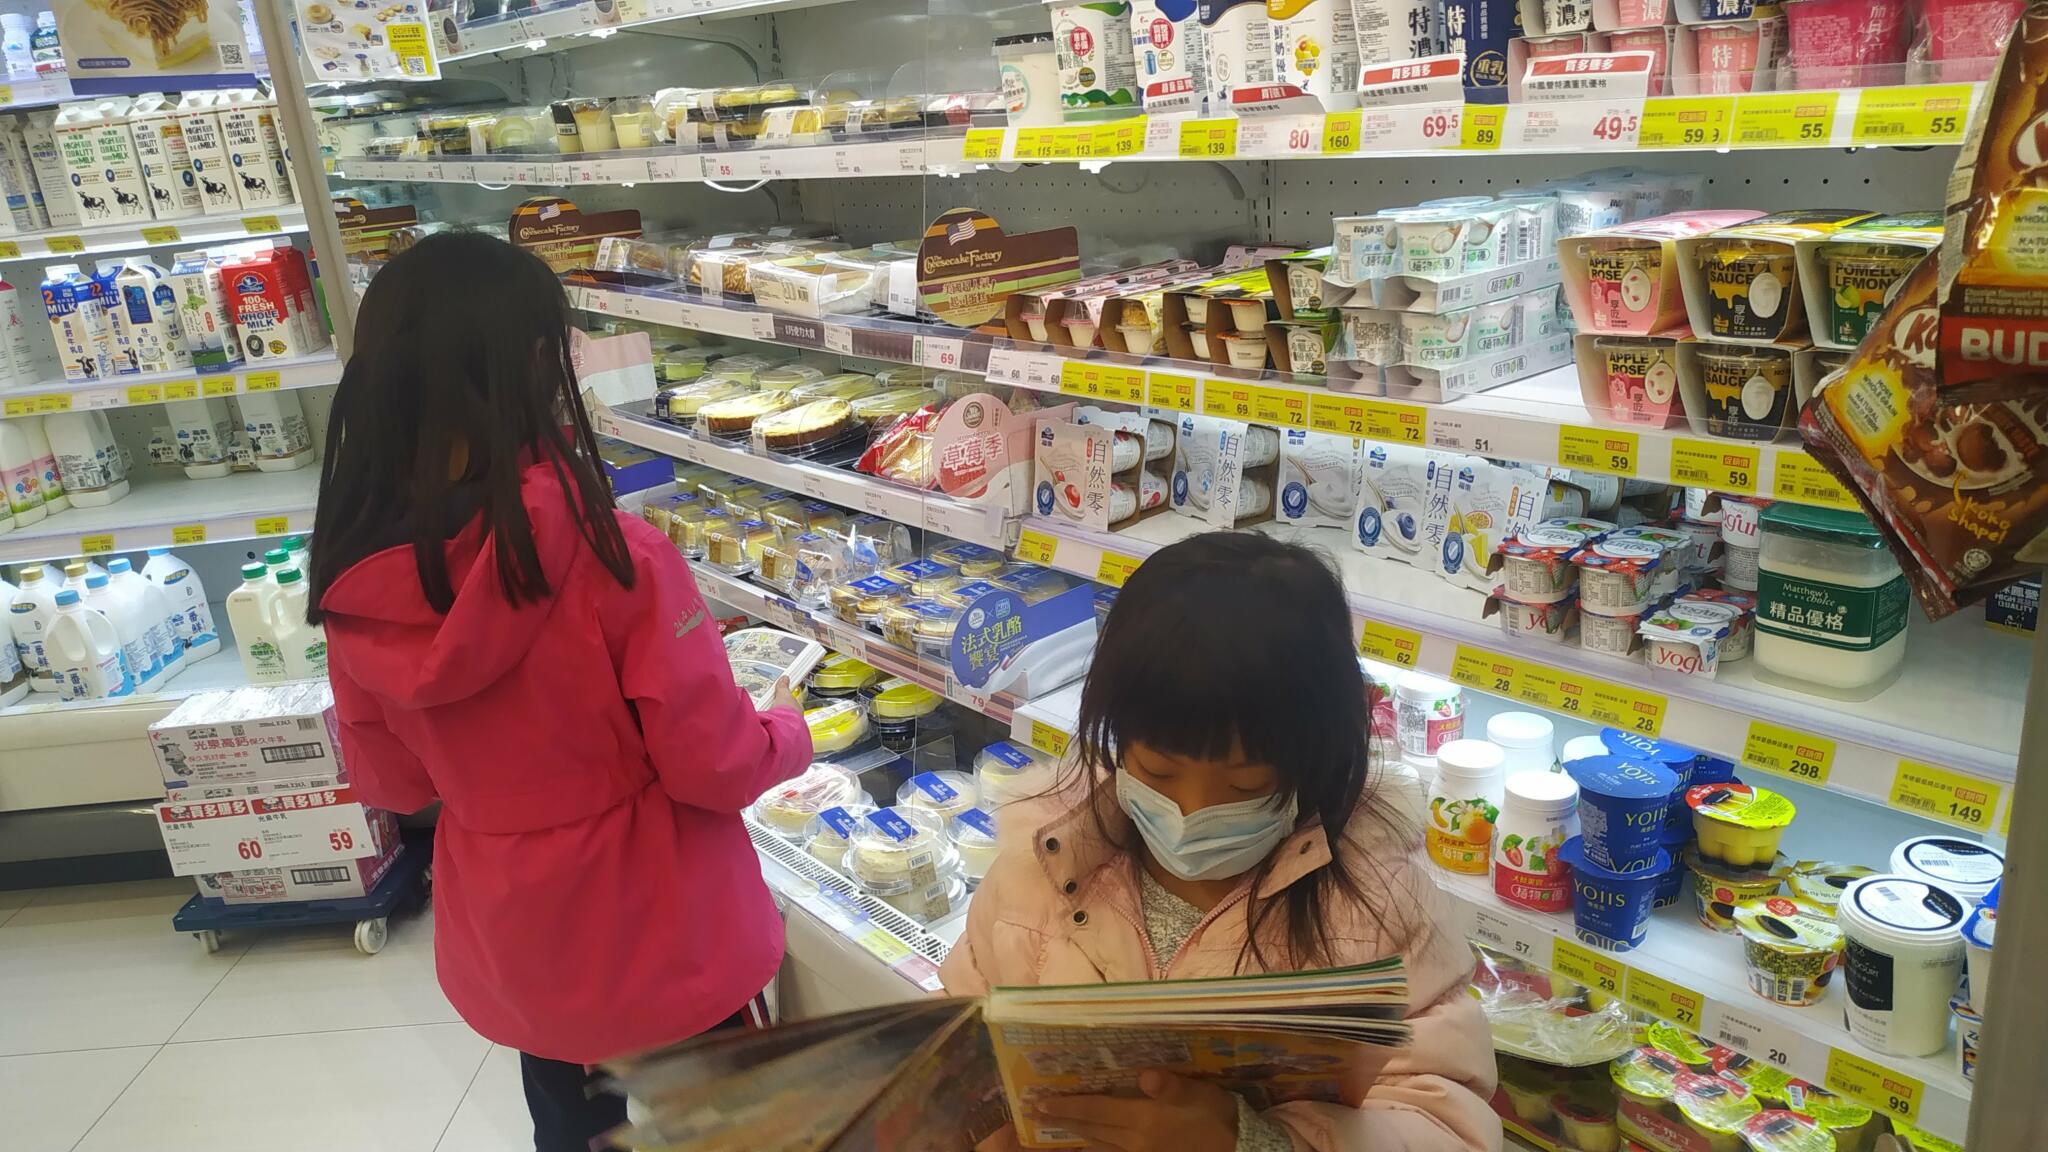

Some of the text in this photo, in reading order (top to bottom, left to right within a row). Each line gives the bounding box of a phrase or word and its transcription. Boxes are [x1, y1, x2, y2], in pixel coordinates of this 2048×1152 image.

[1556, 5, 1577, 27] 濃
[392, 26, 420, 34] COFFEE
[1409, 6, 1432, 58] 特濃
[1478, 59, 1505, 76] 重乳
[186, 126, 201, 134] HIGH
[225, 121, 241, 129] HIGH
[1423, 114, 1458, 138] 69.5
[1593, 115, 1638, 140] 49.5
[1800, 123, 1823, 138] 55
[1930, 117, 1956, 133] 55
[188, 133, 214, 142] QUALITY
[228, 128, 255, 137] QUALITY
[1476, 130, 1494, 143] 89
[1684, 129, 1704, 143] 59
[240, 136, 257, 144] MILK
[1116, 140, 1131, 151] 139
[1289, 130, 1309, 149] 80
[1329, 135, 1349, 148] 160
[65, 148, 94, 157] QUALITY
[100, 144, 127, 153] QUALITY
[984, 148, 997, 158] 155
[1037, 147, 1050, 156] 115
[1076, 145, 1090, 155] 113
[1208, 143, 1224, 153] 139
[720, 166, 731, 175] 55
[553, 224, 580, 235] Factory
[924, 256, 970, 274] Cheesecake
[966, 249, 1002, 267] Factory
[1589, 258, 1625, 270] APPLE
[1710, 261, 1756, 273] HONEY
[1591, 270, 1623, 281] ROSE
[1710, 273, 1755, 285] SAUCE
[44, 290, 54, 304] 2
[47, 303, 77, 314] MILK
[238, 302, 274, 313] FRESH
[238, 310, 279, 321] WHOLE
[247, 318, 274, 329] MILK
[1961, 328, 2048, 366] BUD
[940, 353, 953, 364] 69
[1609, 352, 1649, 365] APPLE
[1011, 370, 1020, 378] 60
[1612, 364, 1646, 375] ROSE
[1705, 363, 1748, 376] HONEY
[1051, 375, 1060, 384] 60
[1705, 375, 1748, 387] SAUCE
[1087, 383, 1097, 393] 59
[1130, 389, 1140, 399] 59
[1179, 398, 1190, 408] 54
[1237, 404, 1248, 415] 69
[1856, 392, 1879, 422] NATURAL
[1289, 412, 1302, 423] 72
[1350, 420, 1362, 432] 72
[1405, 428, 1419, 440] 72
[944, 434, 1002, 468] 草莓季
[1474, 439, 1489, 451] 51
[1605, 440, 1629, 452] 促銷價
[1611, 456, 1628, 469] 59
[1723, 455, 1750, 468] 促銷價
[1087, 440, 1106, 515] 自然零
[1217, 433, 1239, 509] 自然零
[1729, 472, 1748, 486] 59
[1425, 464, 1453, 550] 自然零
[1041, 552, 1049, 561] 62
[1783, 583, 1835, 607] Matthew's choice
[1995, 593, 2016, 603] HIGH
[1998, 601, 2034, 613] QUALITY
[1770, 600, 1844, 632] 精品優格
[962, 615, 1022, 654] 法式乳酪
[1396, 652, 1410, 664] 62
[1492, 663, 1513, 677] 促銷價
[1495, 677, 1509, 692] 28
[1560, 682, 1582, 695] 促銷價
[971, 696, 984, 707] 79
[1564, 697, 1578, 711] 28
[1633, 701, 1657, 715] 促銷價
[1638, 717, 1653, 731] 28
[1796, 746, 1824, 762] 促銷價
[1789, 761, 1819, 779] 298
[1955, 787, 1988, 805] 促銷價
[1949, 803, 1982, 823] 149
[329, 831, 353, 851] 59
[238, 840, 263, 860] 60
[1514, 940, 1529, 953] 57
[1594, 962, 1617, 977] 促銷價
[1600, 977, 1615, 991] 29
[1676, 1008, 1694, 1023] 27
[1768, 1048, 1787, 1064] 20
[1883, 1079, 1912, 1098] 促銷價
[1889, 1096, 1910, 1113] 99
[1636, 1113, 1690, 1145] 統一布丁
